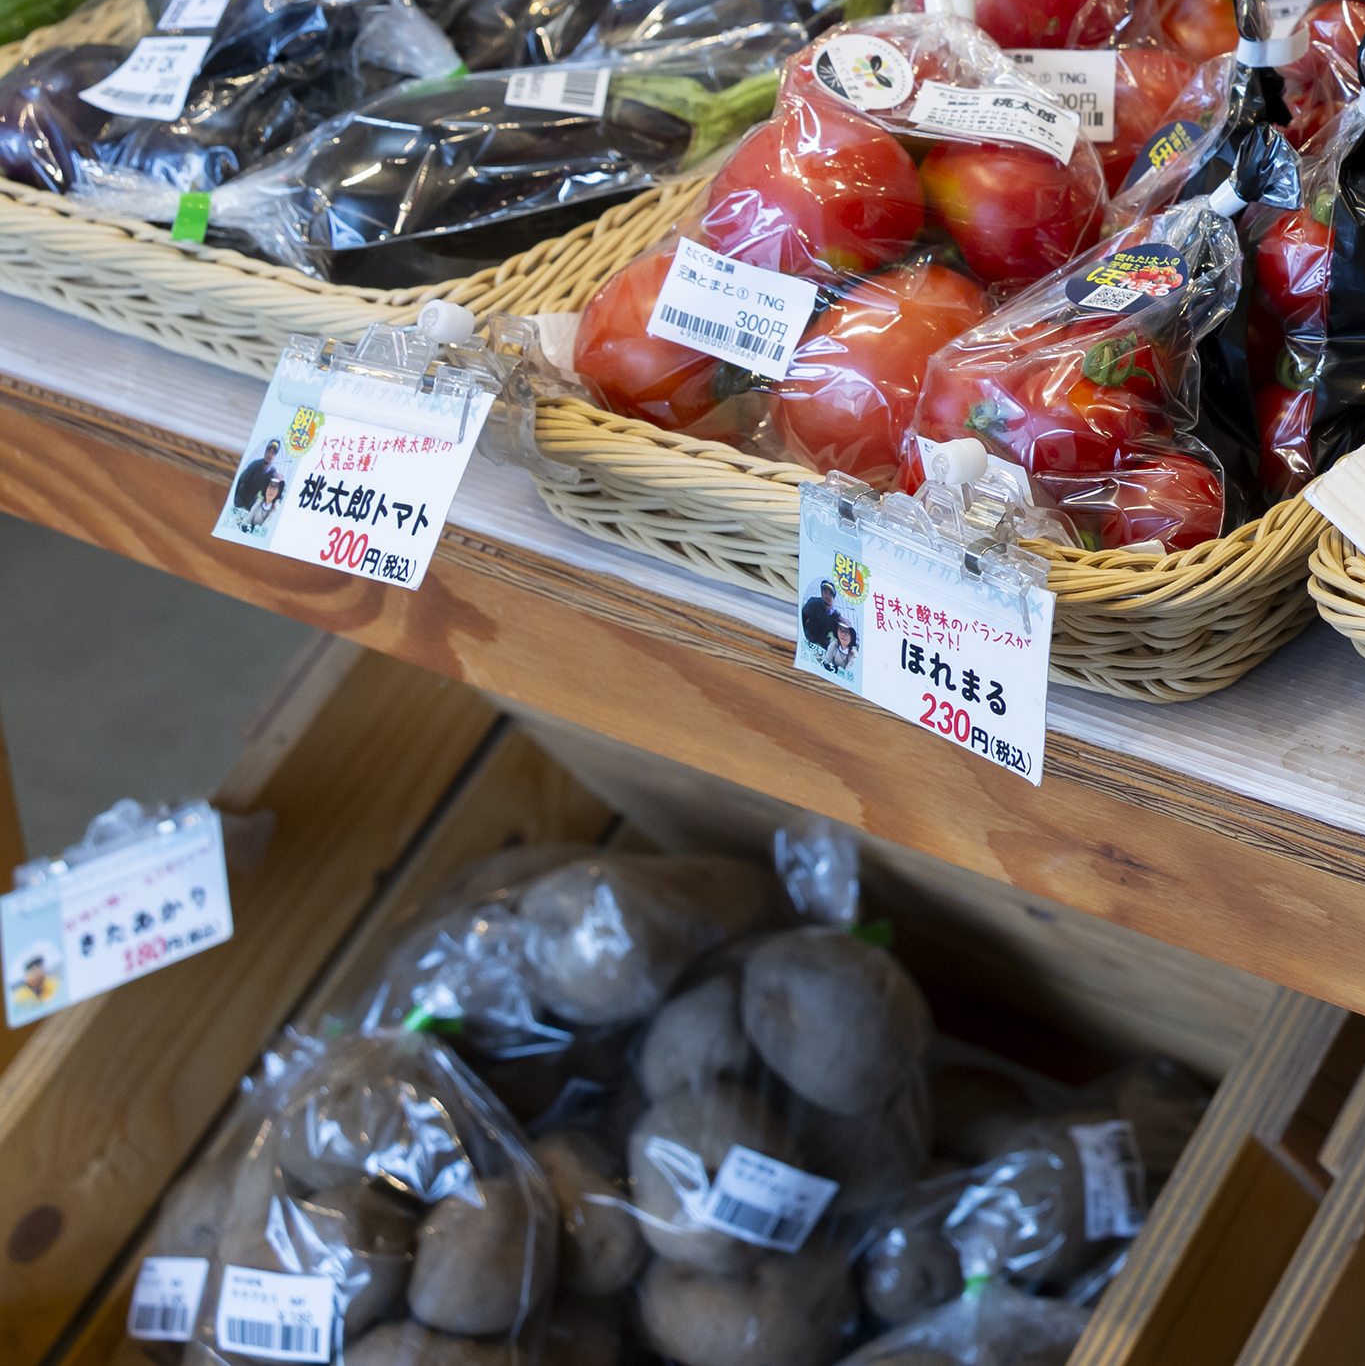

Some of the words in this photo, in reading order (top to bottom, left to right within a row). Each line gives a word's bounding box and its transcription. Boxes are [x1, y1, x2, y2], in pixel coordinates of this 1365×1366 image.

[1058, 72, 1087, 84] TNG
[992, 96, 1059, 125] 桃太郎
[684, 245, 735, 275] たにぐち農園
[1086, 266, 1171, 296] ほれまる
[756, 290, 786, 313] TNG
[735, 310, 789, 344] 300円
[321, 435, 453, 454] トマトと言えば桃太郎!の
[314, 453, 378, 473] 人気品種!
[299, 472, 429, 536] 桃太郎トマト
[320, 526, 417, 584] 300円(税込)
[873, 592, 1032, 649] 甘味と酸味のバランスが
[876, 609, 960, 652] 良いミニトマト!
[901, 638, 1007, 716] ほれまる
[920, 692, 1032, 776] 230円(税込)
